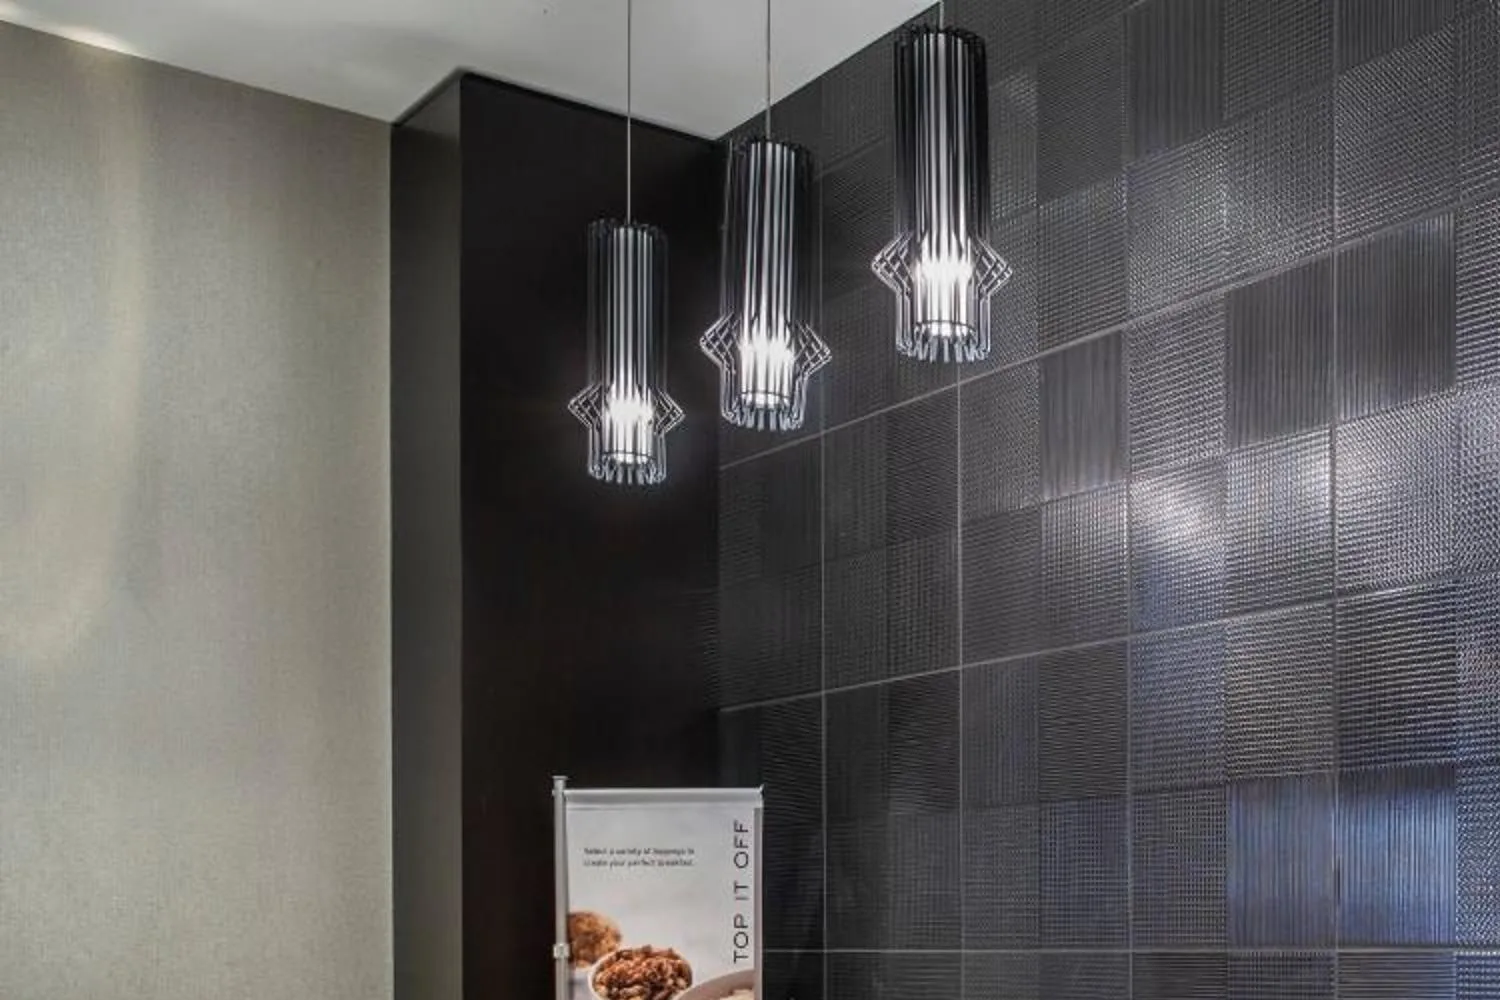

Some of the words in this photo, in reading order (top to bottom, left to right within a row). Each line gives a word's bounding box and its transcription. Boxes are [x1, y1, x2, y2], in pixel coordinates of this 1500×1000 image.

[733, 820, 749, 869] OFF
[733, 881, 749, 901] IT
[733, 913, 749, 964] TOP
